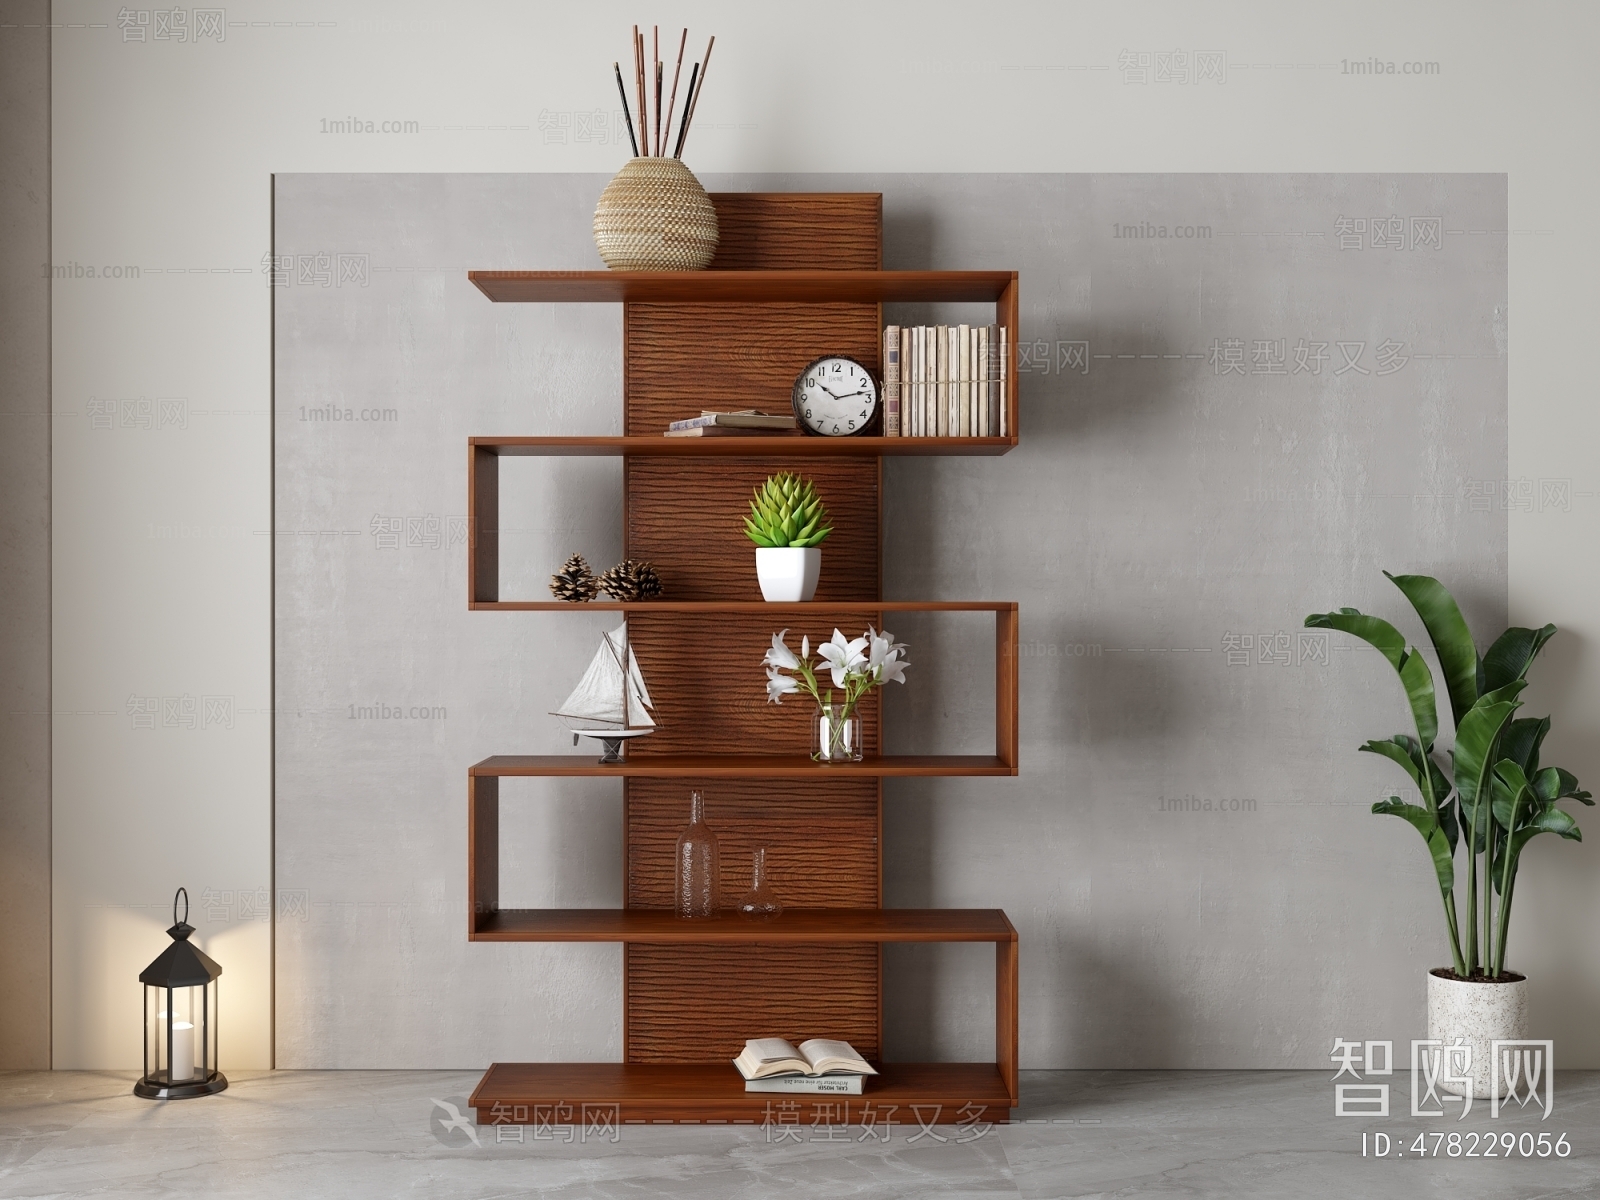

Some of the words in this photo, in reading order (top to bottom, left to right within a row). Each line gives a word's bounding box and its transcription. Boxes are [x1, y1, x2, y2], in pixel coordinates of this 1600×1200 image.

[818, 366, 825, 376] 11
[832, 363, 842, 372] 12
[805, 378, 815, 388] 10
[859, 378, 867, 387] 2
[801, 394, 808, 403] 9
[864, 394, 872, 403] 3
[805, 409, 812, 419] 8
[859, 409, 867, 419] 4
[816, 420, 824, 430] 7
[832, 424, 840, 434] 6
[848, 420, 855, 430] 5
